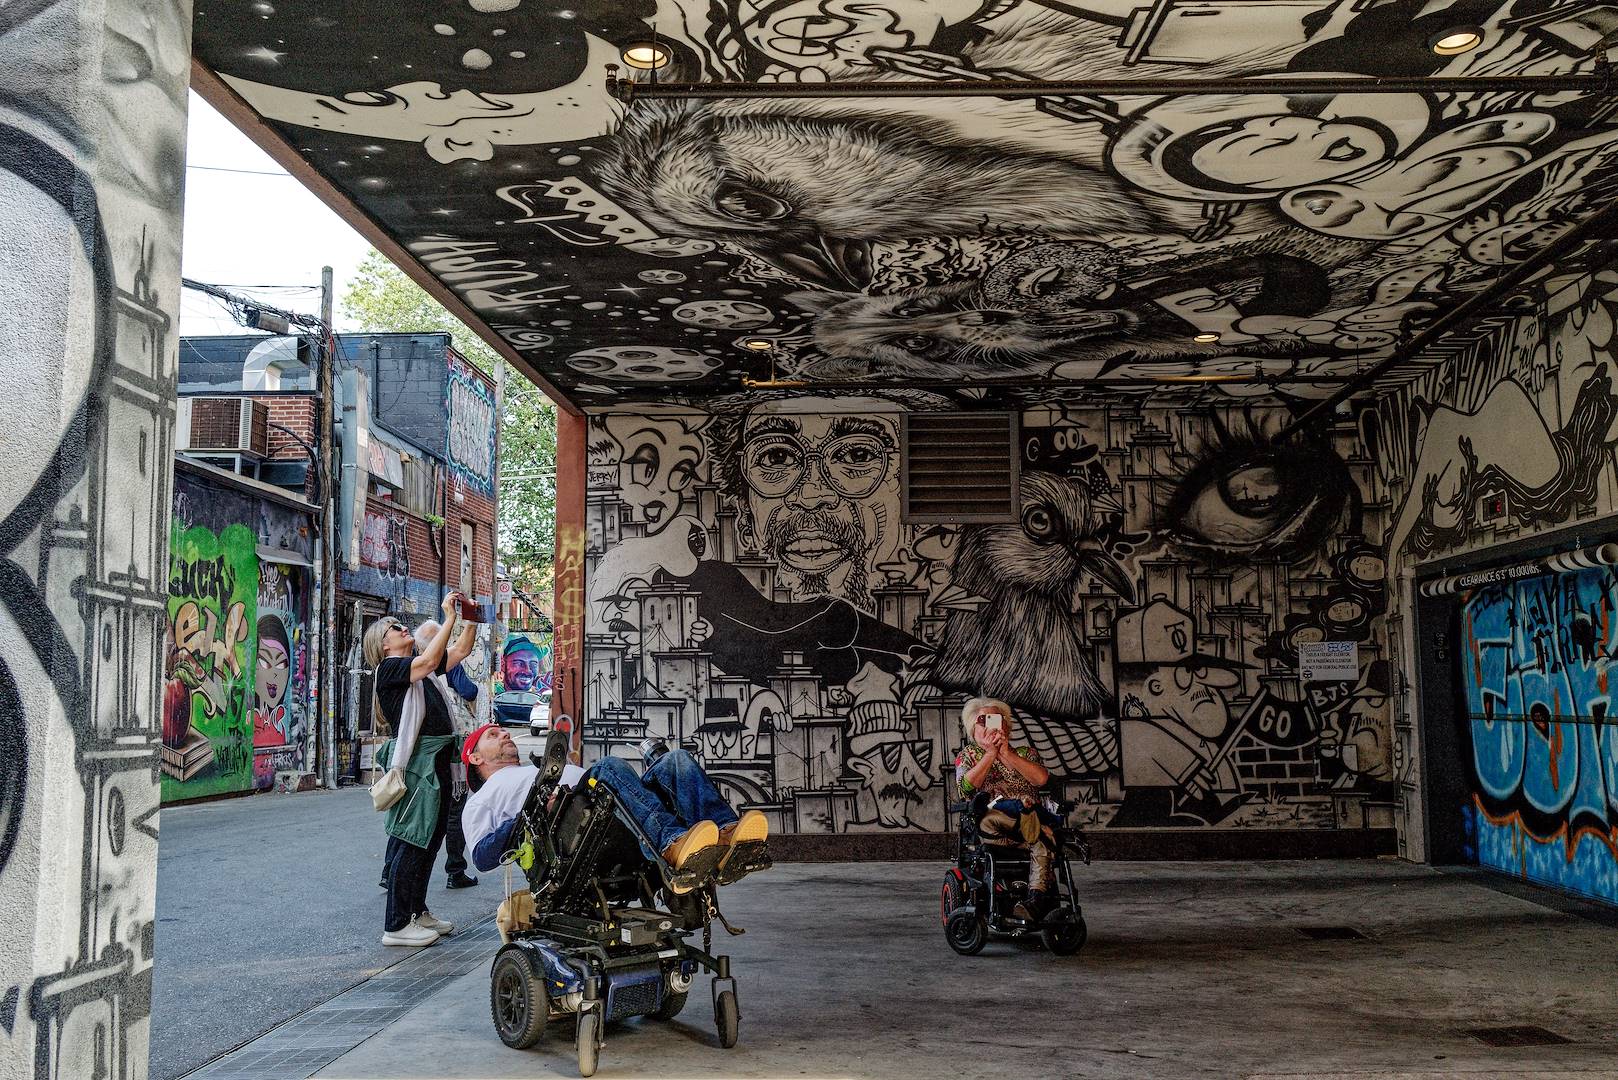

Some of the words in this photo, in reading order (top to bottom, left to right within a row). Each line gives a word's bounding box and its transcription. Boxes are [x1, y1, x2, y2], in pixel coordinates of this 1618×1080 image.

[1459, 571, 1495, 588] CLEARANCE
[1311, 681, 1349, 707] BJS
[1259, 705, 1292, 739] GO
